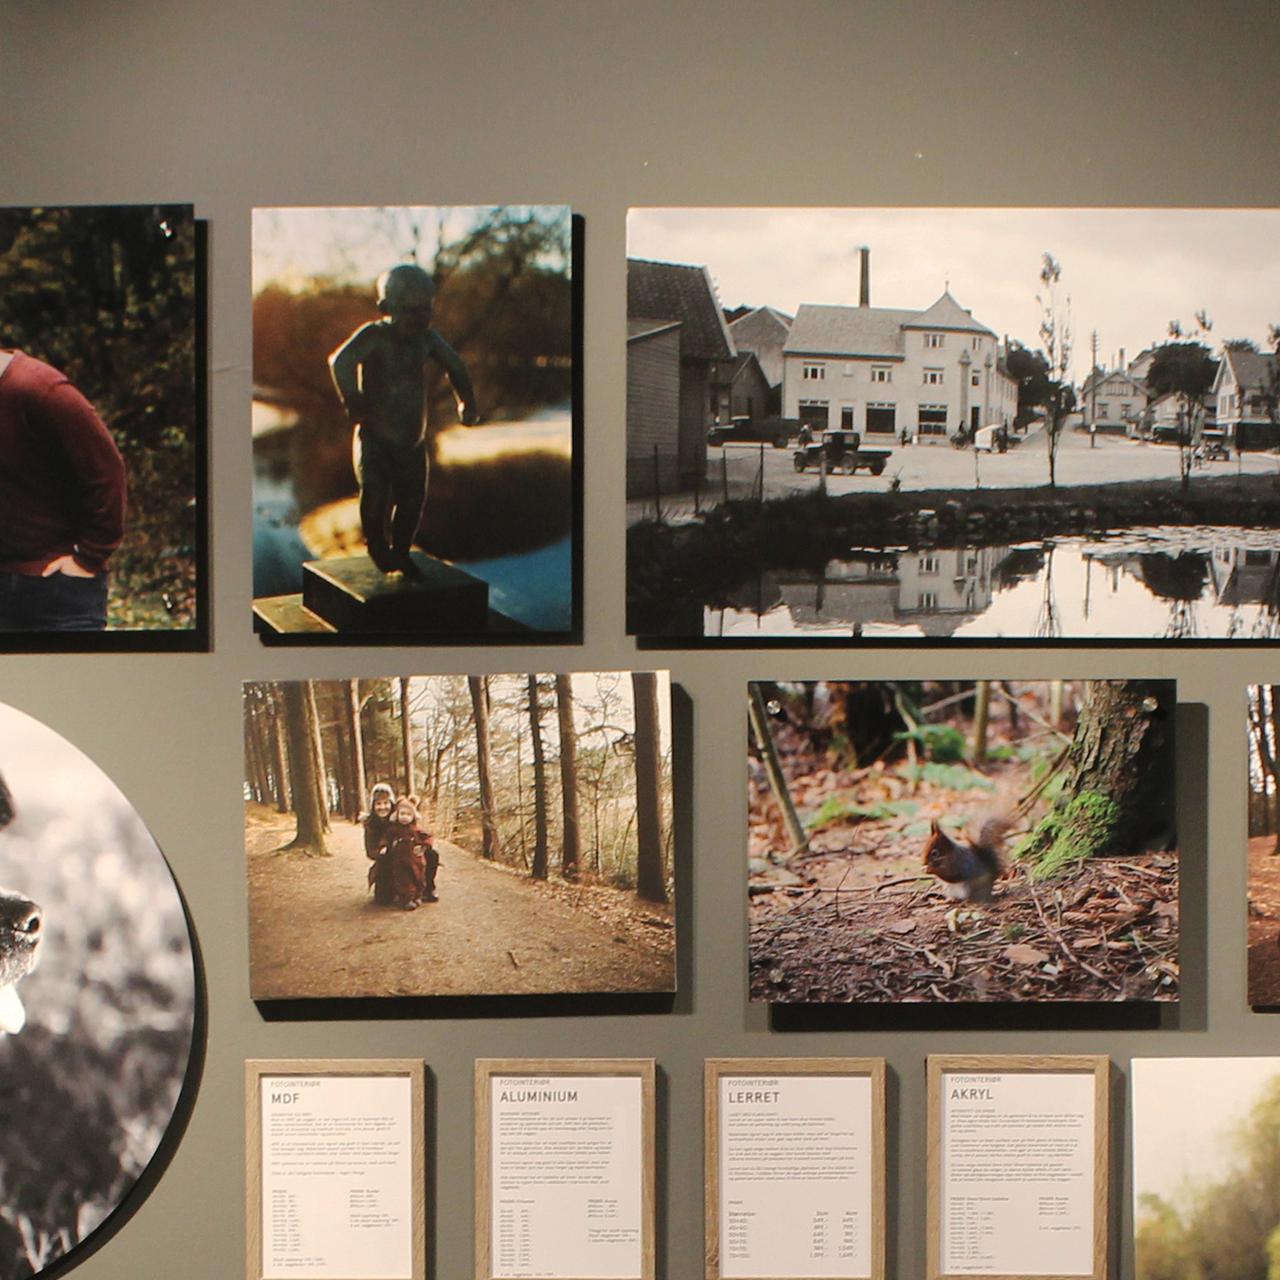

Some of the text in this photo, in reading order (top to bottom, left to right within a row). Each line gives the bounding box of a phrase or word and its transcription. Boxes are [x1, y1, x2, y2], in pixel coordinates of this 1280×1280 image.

[271, 1093, 300, 1105] MDF
[500, 1091, 579, 1103] ALUMINIUM
[728, 1091, 780, 1104] LERRET
[951, 1088, 994, 1101] AKRYL
